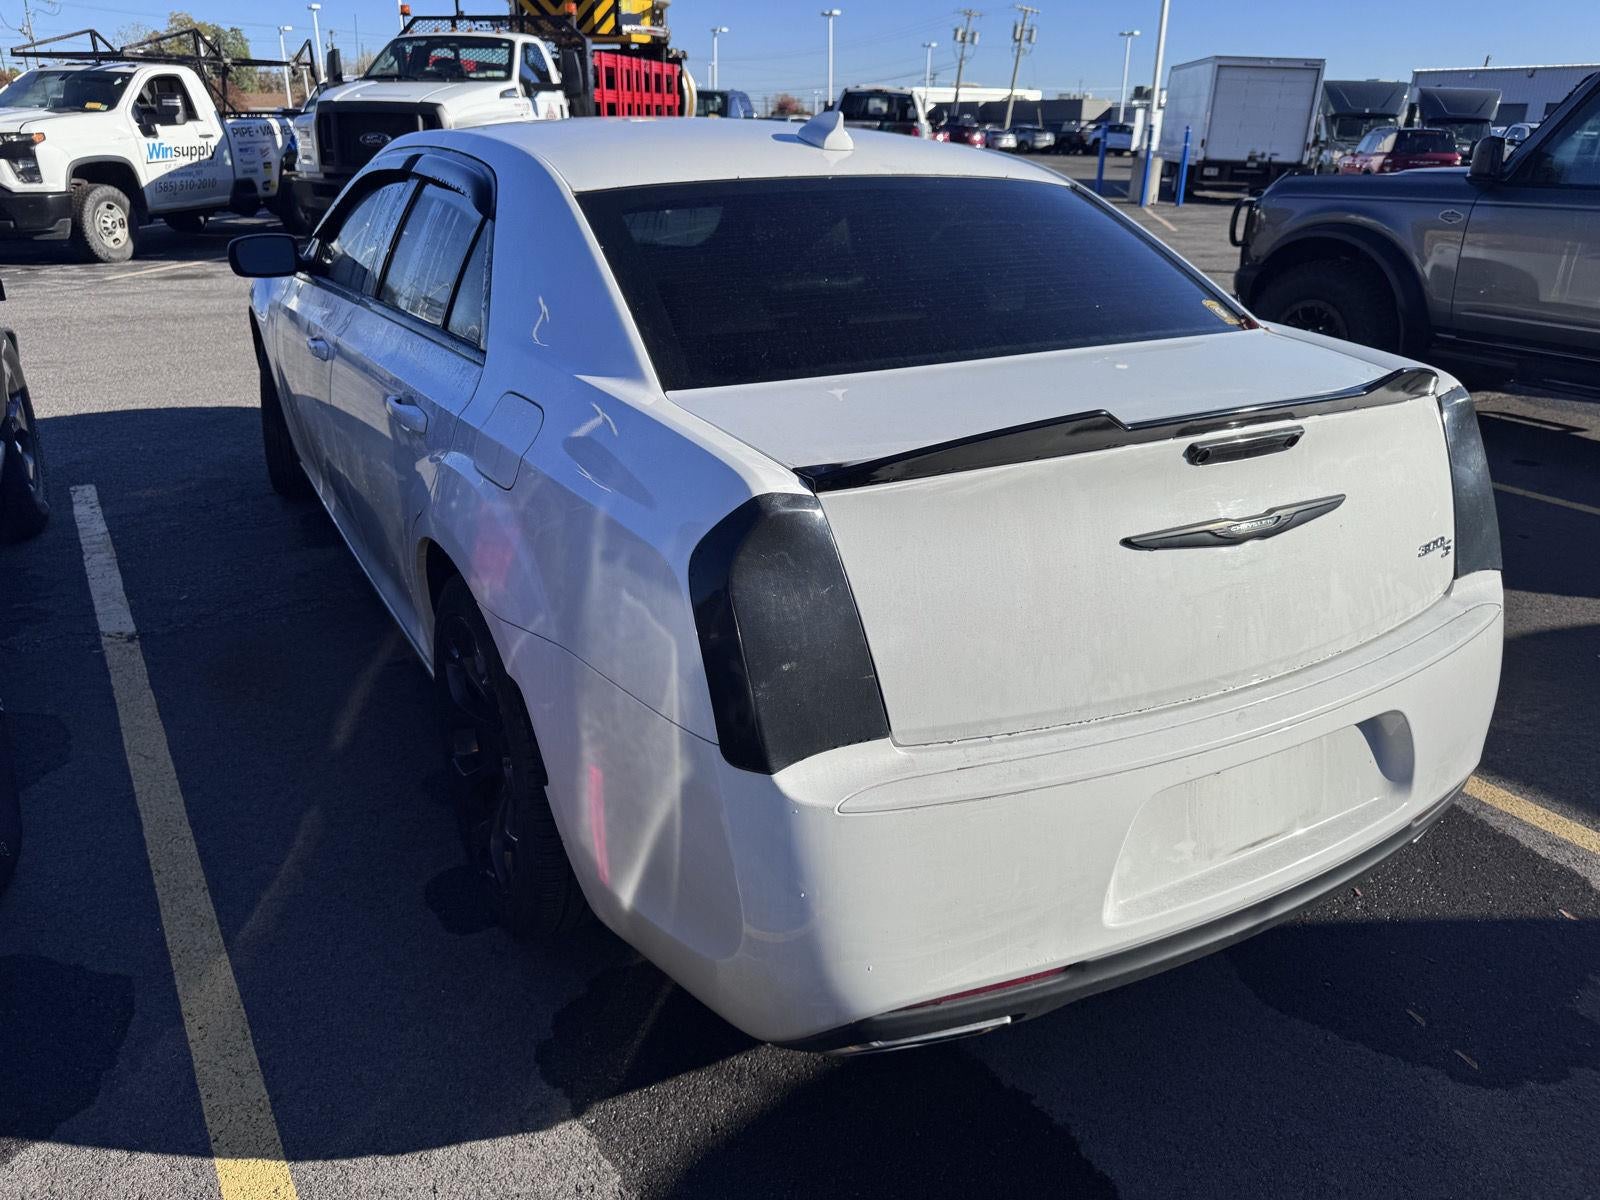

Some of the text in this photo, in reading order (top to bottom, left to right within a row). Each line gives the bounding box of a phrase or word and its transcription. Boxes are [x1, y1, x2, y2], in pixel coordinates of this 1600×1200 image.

[231, 126, 254, 138] PIPE
[147, 141, 217, 161] Winsupply
[155, 181, 177, 193] (585)
